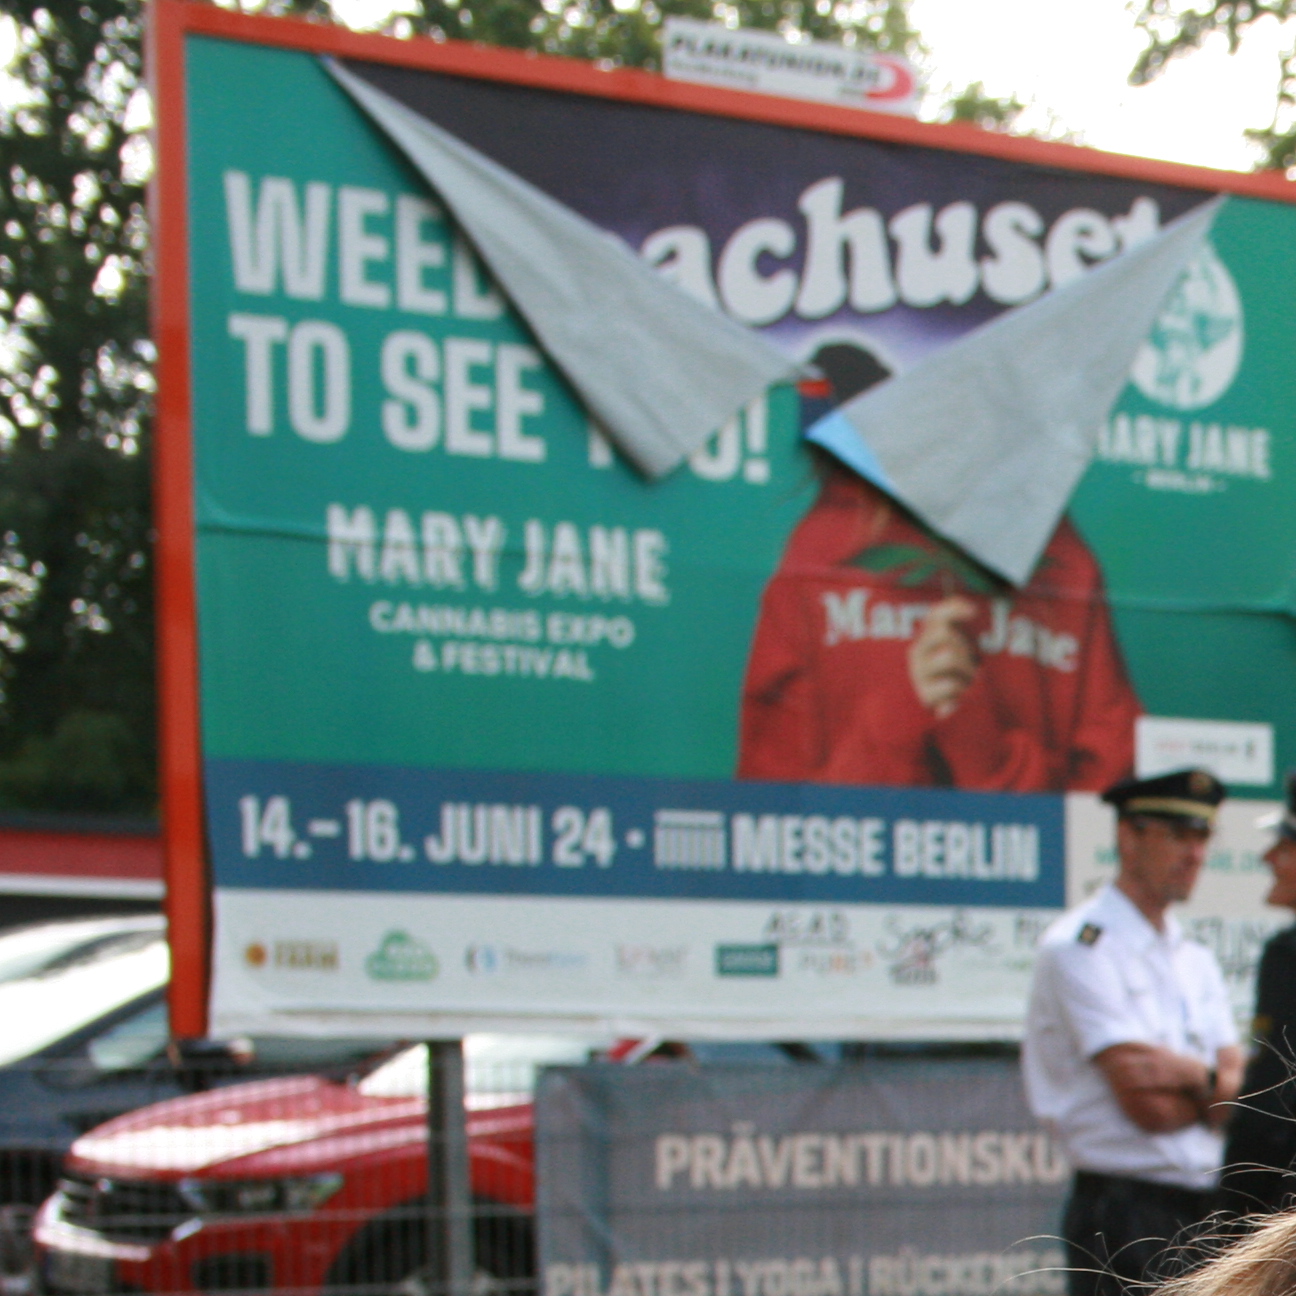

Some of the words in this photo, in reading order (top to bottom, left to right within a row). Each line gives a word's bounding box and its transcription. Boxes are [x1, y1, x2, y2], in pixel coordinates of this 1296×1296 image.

[227, 312, 352, 444] TO
[381, 330, 547, 464] SEE
[326, 503, 505, 594] MARY
[517, 518, 672, 606] JANE
[368, 599, 542, 643] CANNABIS
[545, 611, 636, 649] EXPO
[412, 637, 438, 673] &
[440, 641, 595, 682] FESTIVAL
[424, 803, 542, 866] JUNI
[551, 805, 616, 869] 24
[731, 793, 888, 876] MESSE
[893, 800, 1041, 883] BERLIN
